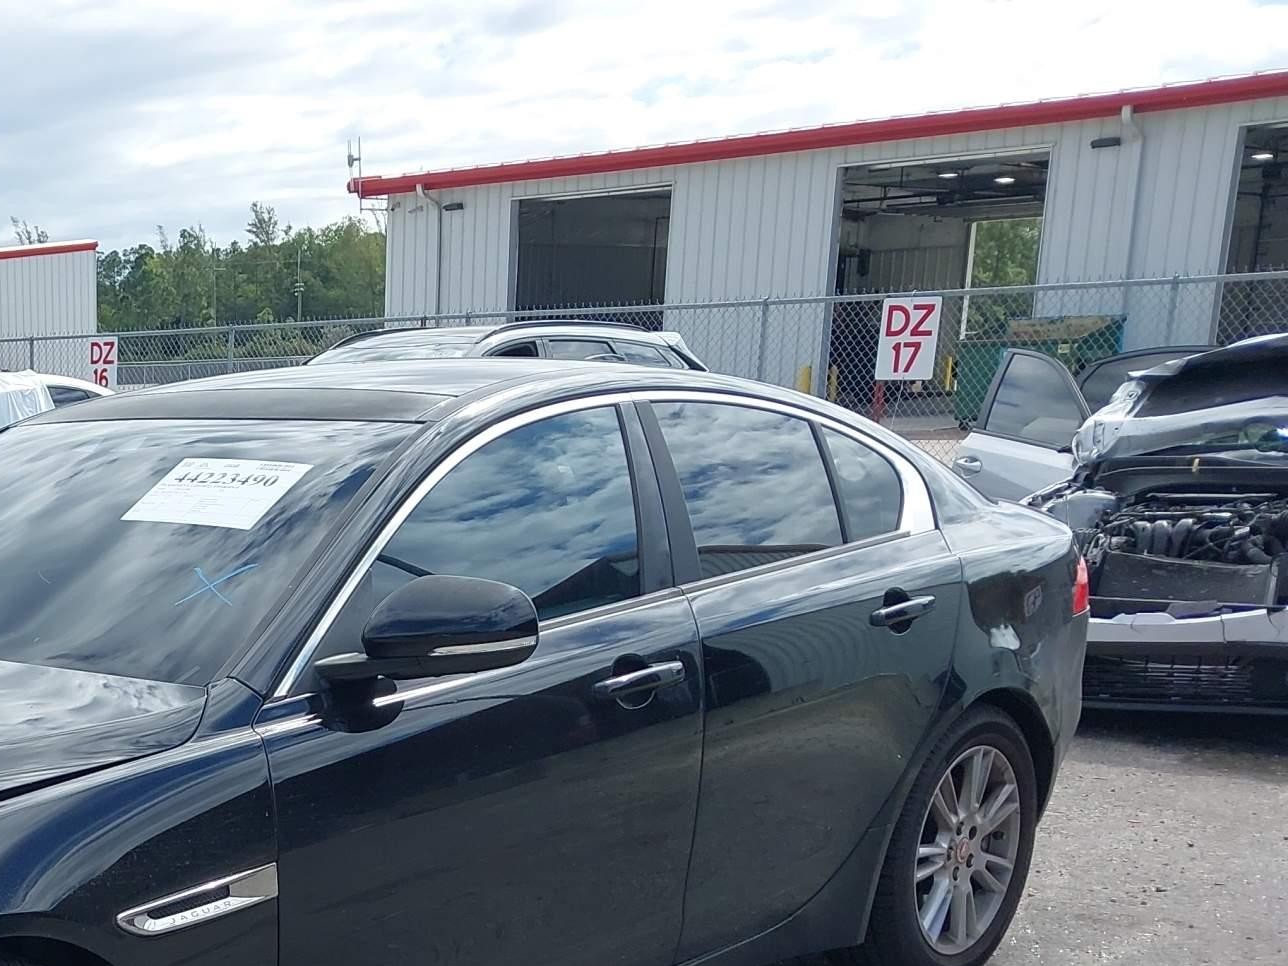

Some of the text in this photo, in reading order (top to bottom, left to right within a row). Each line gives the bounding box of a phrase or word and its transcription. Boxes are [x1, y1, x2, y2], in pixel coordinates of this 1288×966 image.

[885, 303, 936, 337] DZ
[90, 341, 115, 365] DZ
[892, 341, 922, 373] 17
[93, 367, 109, 388] 16
[174, 470, 280, 488] 44223490
[169, 900, 232, 925] JAGUAR
